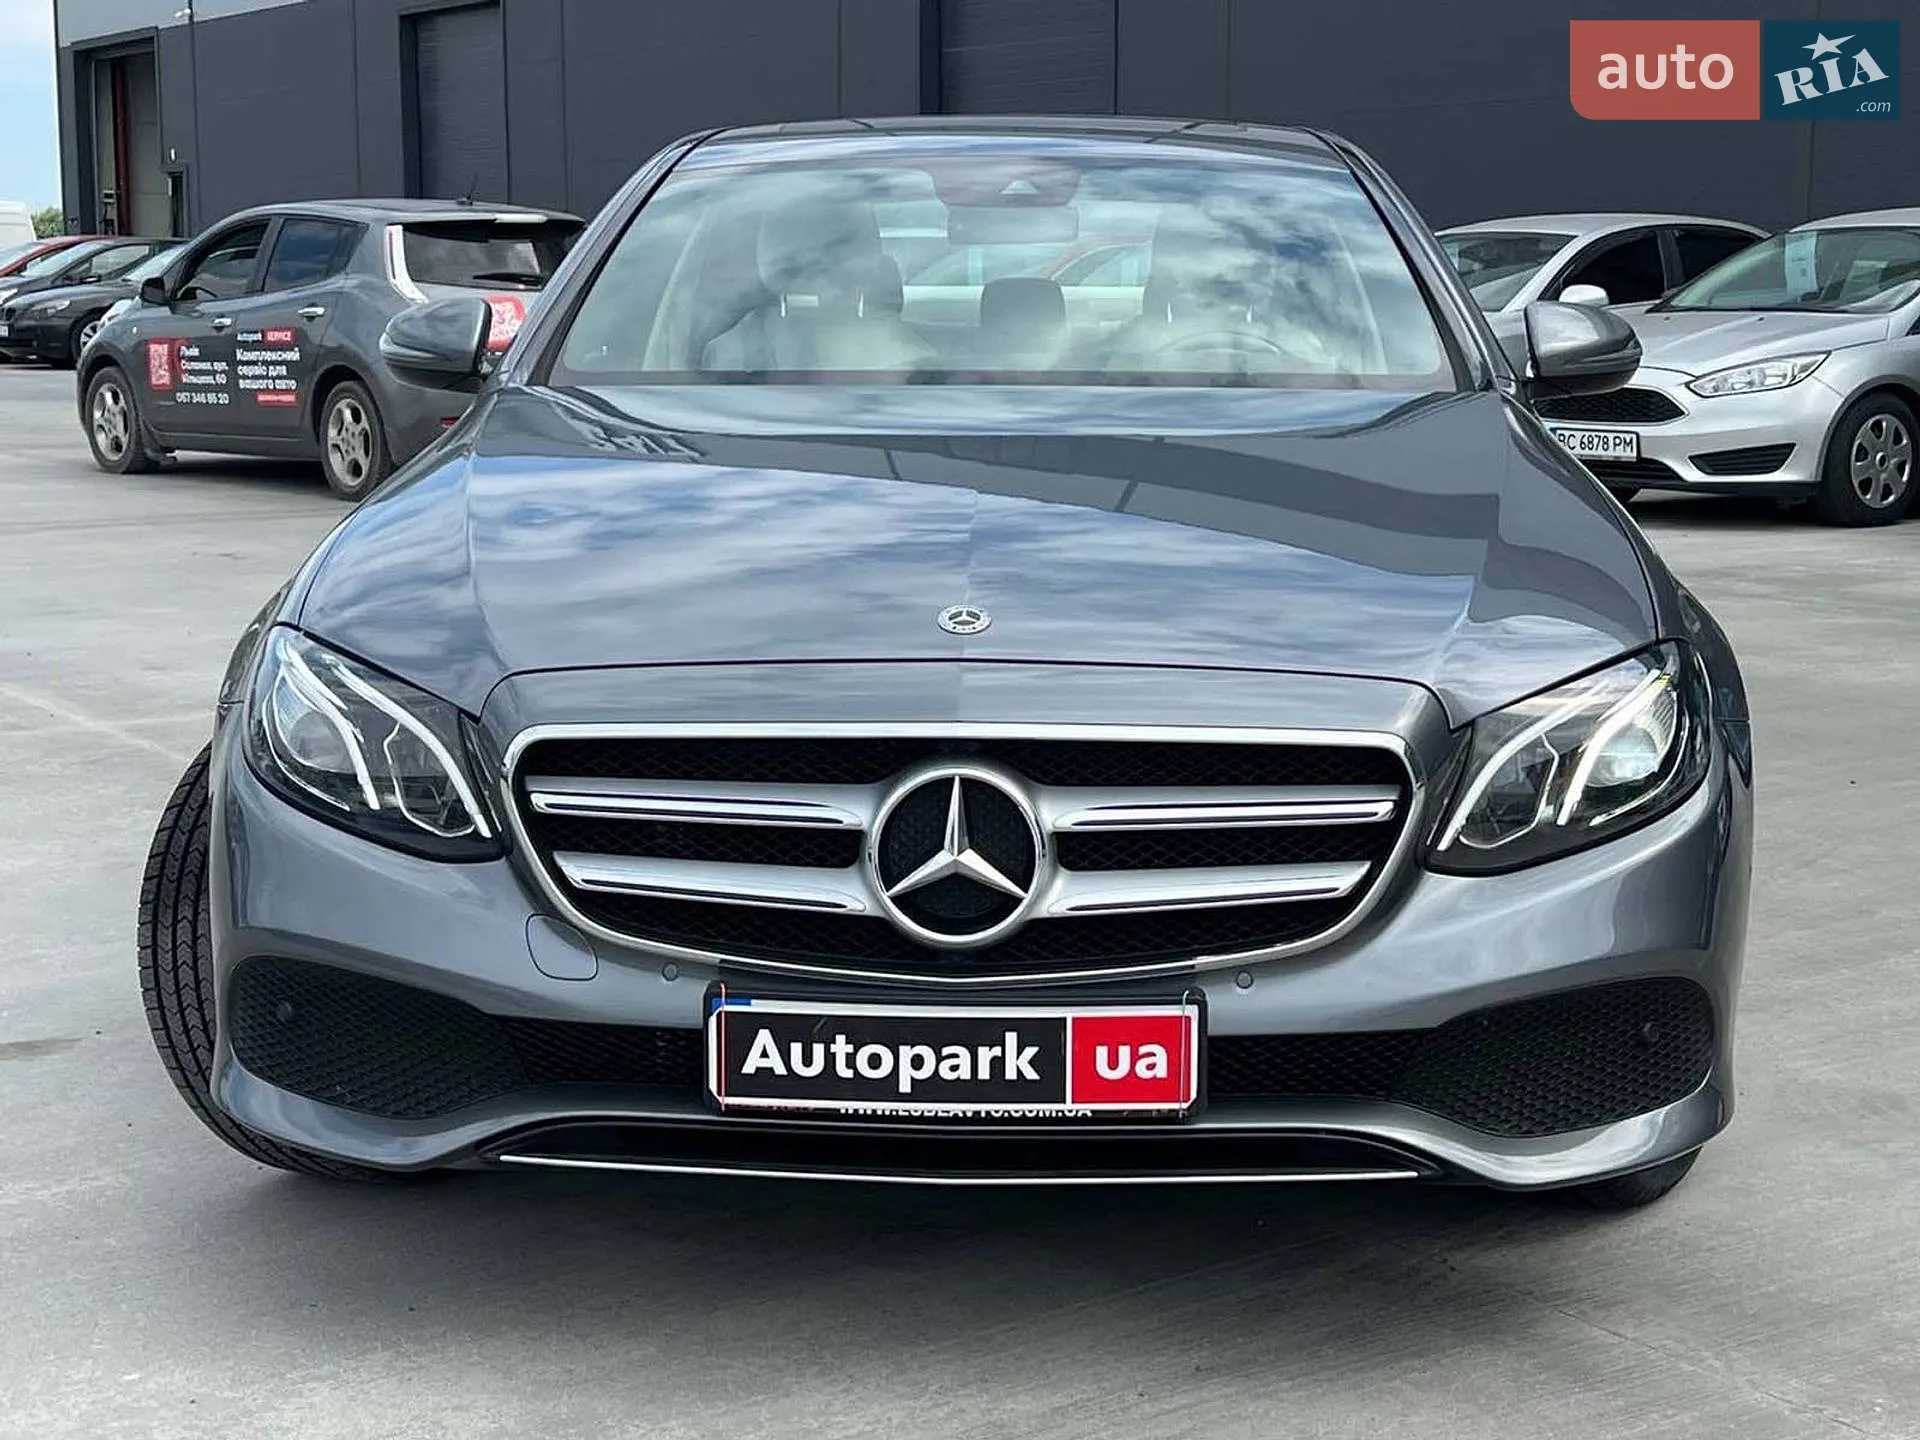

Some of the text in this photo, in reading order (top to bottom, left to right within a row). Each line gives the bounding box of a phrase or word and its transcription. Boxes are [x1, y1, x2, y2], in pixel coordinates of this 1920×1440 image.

[237, 362, 288, 377] сервіс для
[1580, 434, 1610, 452] 6878
[1612, 435, 1634, 453] PM
[741, 1027, 1168, 1093] Autopark ua
